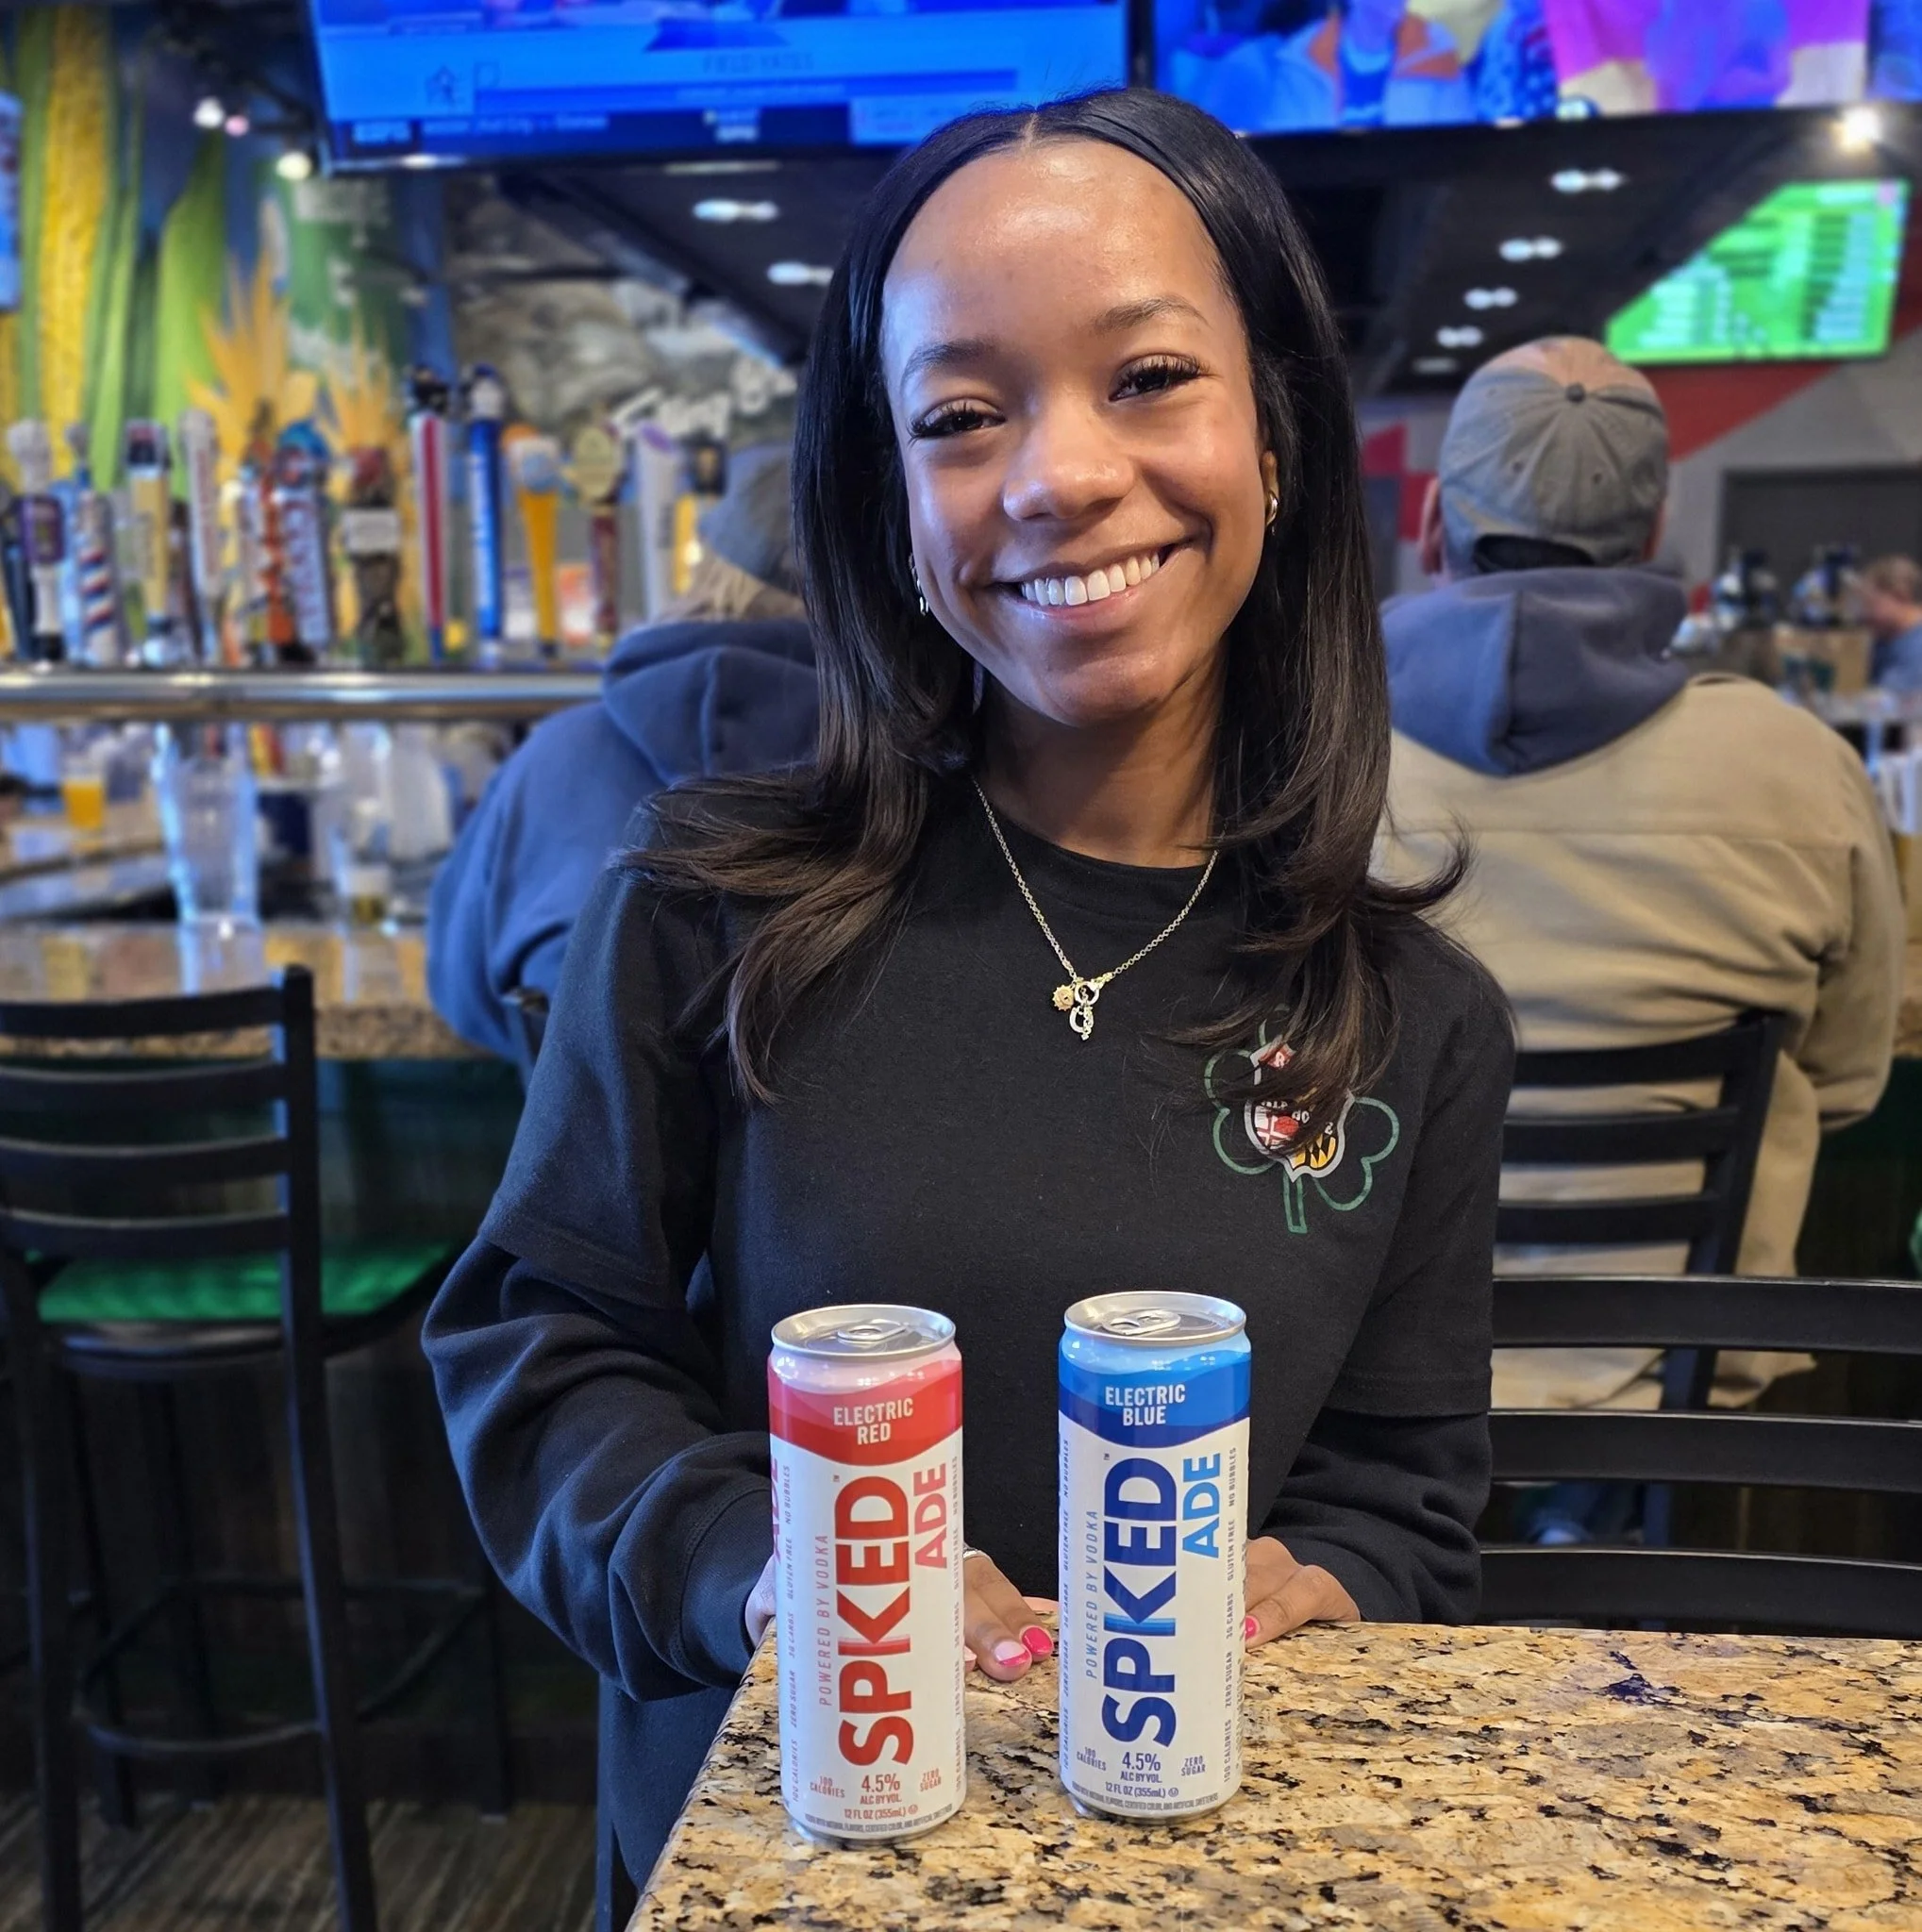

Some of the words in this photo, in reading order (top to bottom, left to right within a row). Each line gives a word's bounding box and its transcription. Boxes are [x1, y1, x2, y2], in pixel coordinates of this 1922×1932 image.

[1105, 1384, 1185, 1407] ELECTRIC
[833, 1398, 913, 1426] ELECTRIC
[1123, 1406, 1166, 1426] BLUE
[857, 1423, 891, 1445] RED
[1182, 1453, 1221, 1558] ADE
[1228, 1492, 1235, 1507] NO
[784, 1510, 792, 1524] NO
[913, 1463, 947, 1569] ADE
[1086, 1511, 1097, 1564] VODKA
[815, 1535, 829, 1590] VODKA
[785, 1563, 794, 1600] GLUTEN
[1086, 1572, 1097, 1593] BY
[816, 1599, 829, 1618] BY
[1101, 1457, 1177, 1747] SPIKED
[787, 1611, 795, 1643] CARBS
[835, 1476, 913, 1766] SPIKED
[1086, 1602, 1097, 1679] POWERED
[817, 1627, 831, 1706] POWERED
[789, 1670, 797, 1702] SUGAR
[791, 1739, 799, 1784] CALORIES
[1077, 1751, 1106, 1772] CALORIES
[1085, 1747, 1096, 1757] 100
[1122, 1752, 1161, 1772] 4.5%
[1184, 1756, 1203, 1767] ZERO
[923, 1768, 940, 1783] ZERO
[1120, 1772, 1134, 1781] ALC
[1135, 1773, 1145, 1782] BY
[1146, 1773, 1162, 1783] VOL.
[1181, 1764, 1206, 1776] SUGAR
[810, 1782, 845, 1798] CALORIES
[820, 1775, 833, 1787] 100
[861, 1774, 900, 1793] 4.5%
[920, 1776, 942, 1792] SUGAR
[1105, 1782, 1112, 1791] 12
[1114, 1784, 1123, 1794] FL
[1123, 1786, 1133, 1795] OZ
[1134, 1786, 1166, 1798] (355mL)
[860, 1795, 874, 1805] ALC
[876, 1794, 886, 1805] BY
[844, 1808, 852, 1819] 12
[853, 1809, 862, 1820] FL
[863, 1809, 874, 1820] OZ
[875, 1807, 907, 1821] (355mL)
